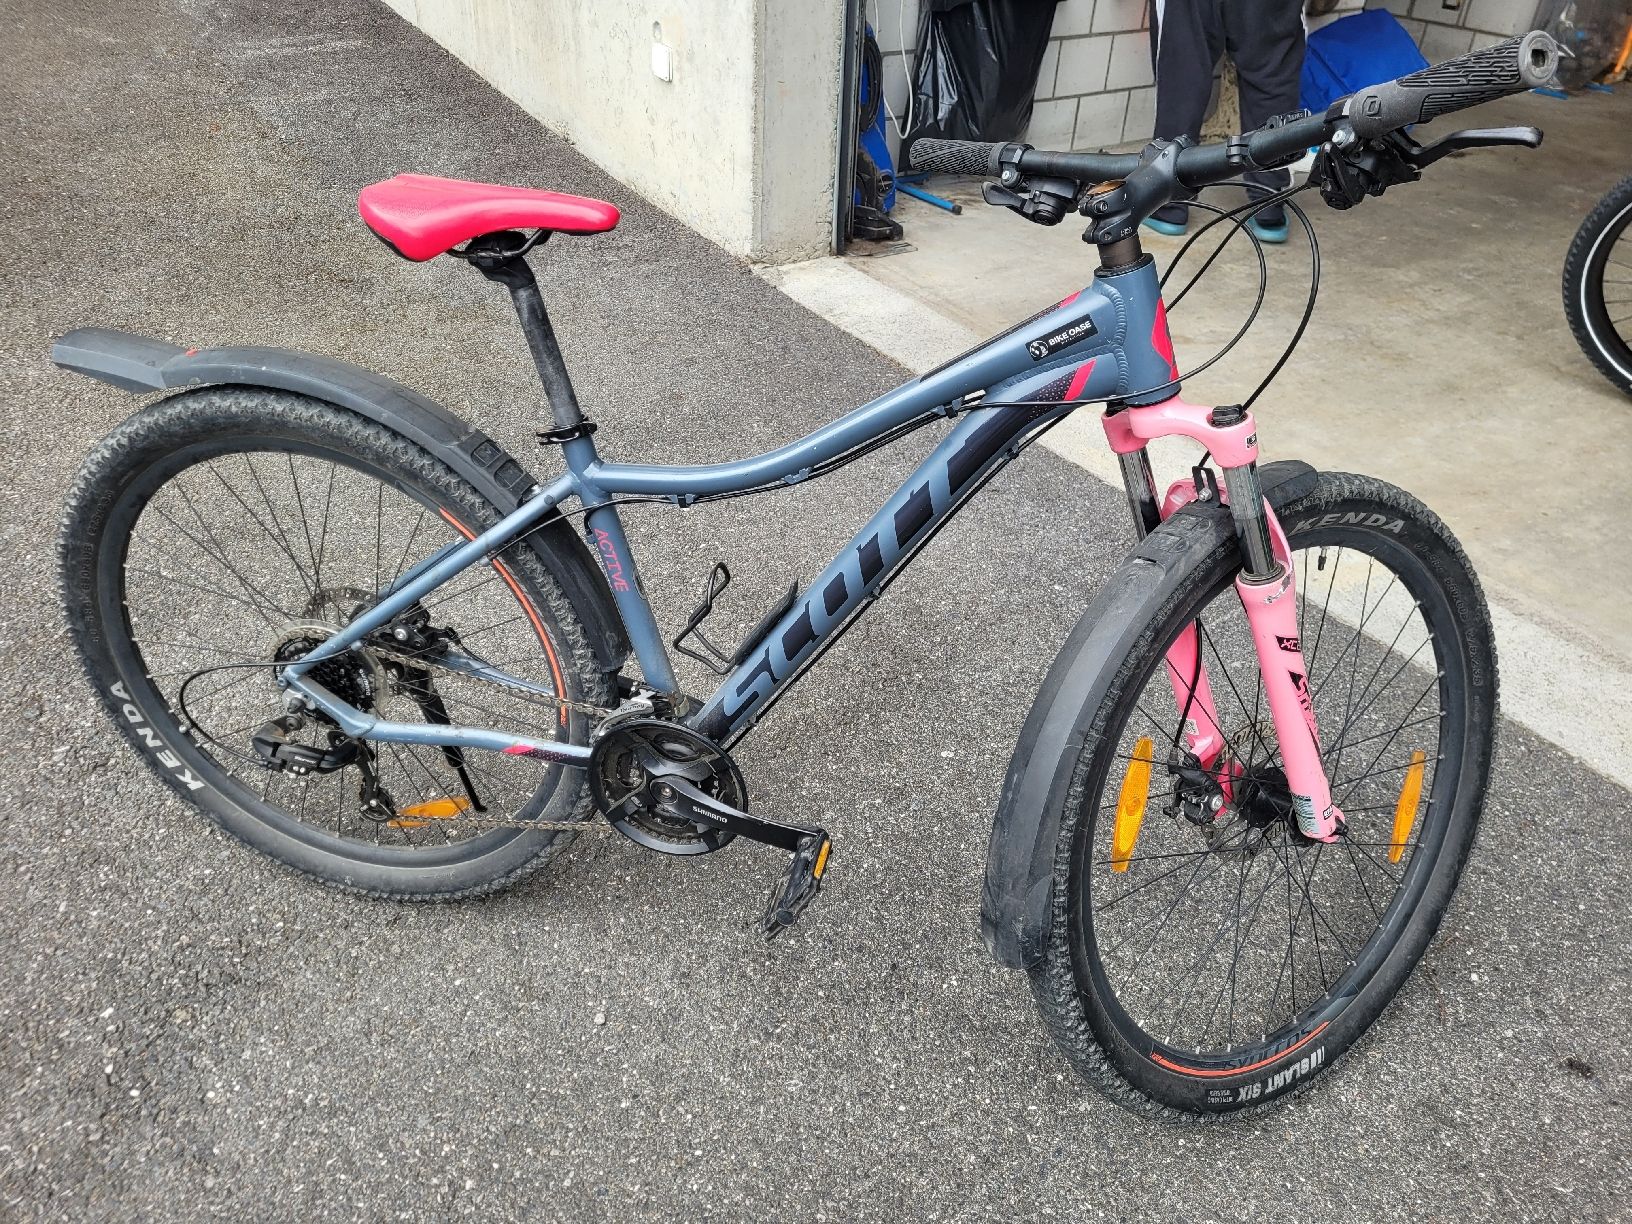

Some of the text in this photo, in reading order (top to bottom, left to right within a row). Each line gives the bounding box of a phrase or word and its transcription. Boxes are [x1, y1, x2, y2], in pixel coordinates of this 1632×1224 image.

[1048, 331, 1069, 346] BIKE
[1068, 320, 1092, 336] OASE
[1289, 511, 1406, 536] KENDA
[594, 528, 630, 592] ACTIVE
[722, 430, 968, 733] SCOTT
[110, 680, 206, 791] KENDA
[692, 805, 728, 824] SHIMANO
[1236, 1081, 1262, 1103] SIX
[1264, 1057, 1310, 1095] SLANT
